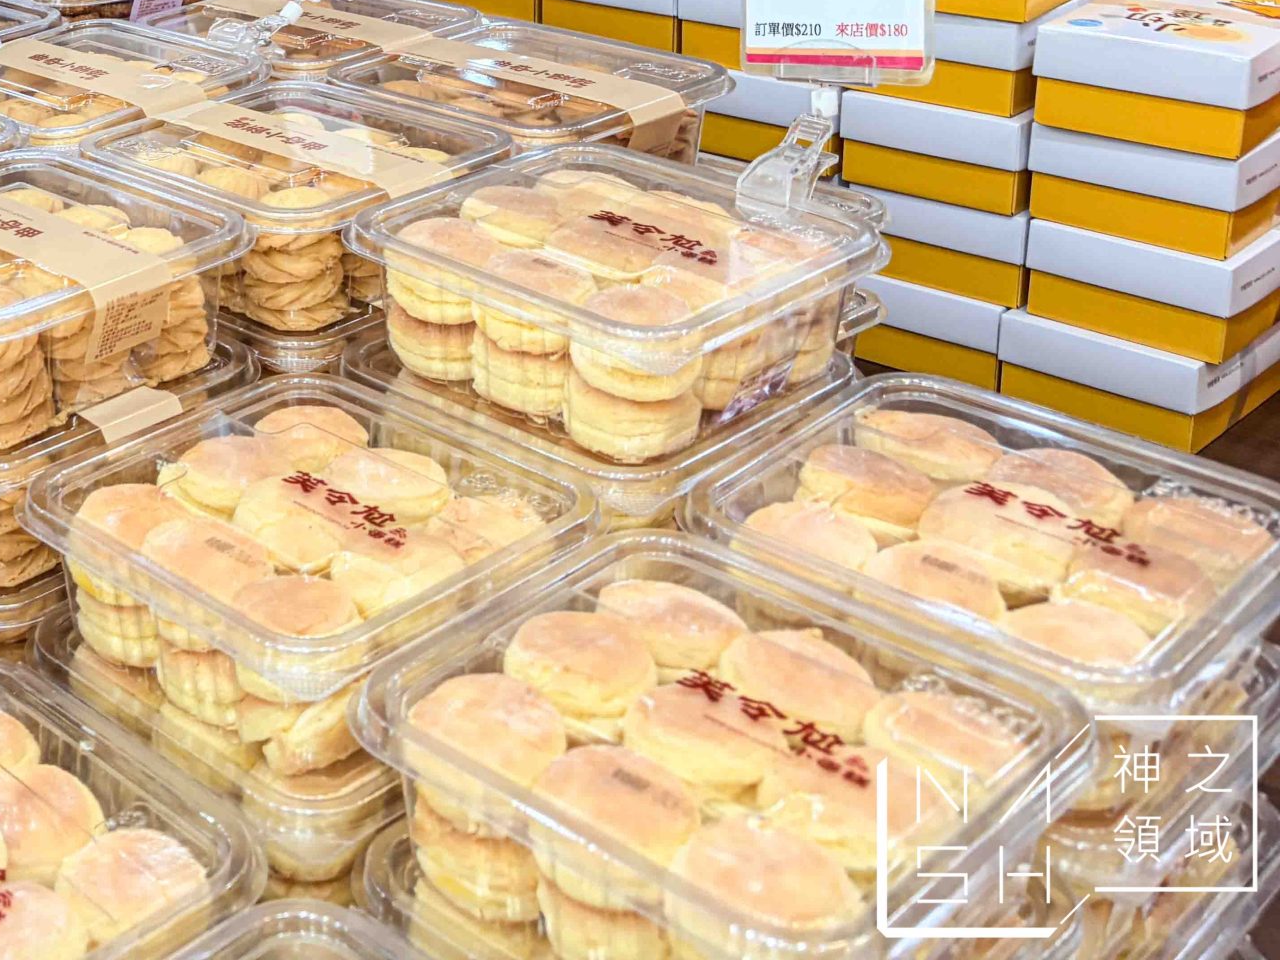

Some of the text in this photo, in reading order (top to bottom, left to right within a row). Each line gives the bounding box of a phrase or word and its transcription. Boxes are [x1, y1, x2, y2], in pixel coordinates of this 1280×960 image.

[754, 22, 908, 37] 訂單價$210 來店價$180
